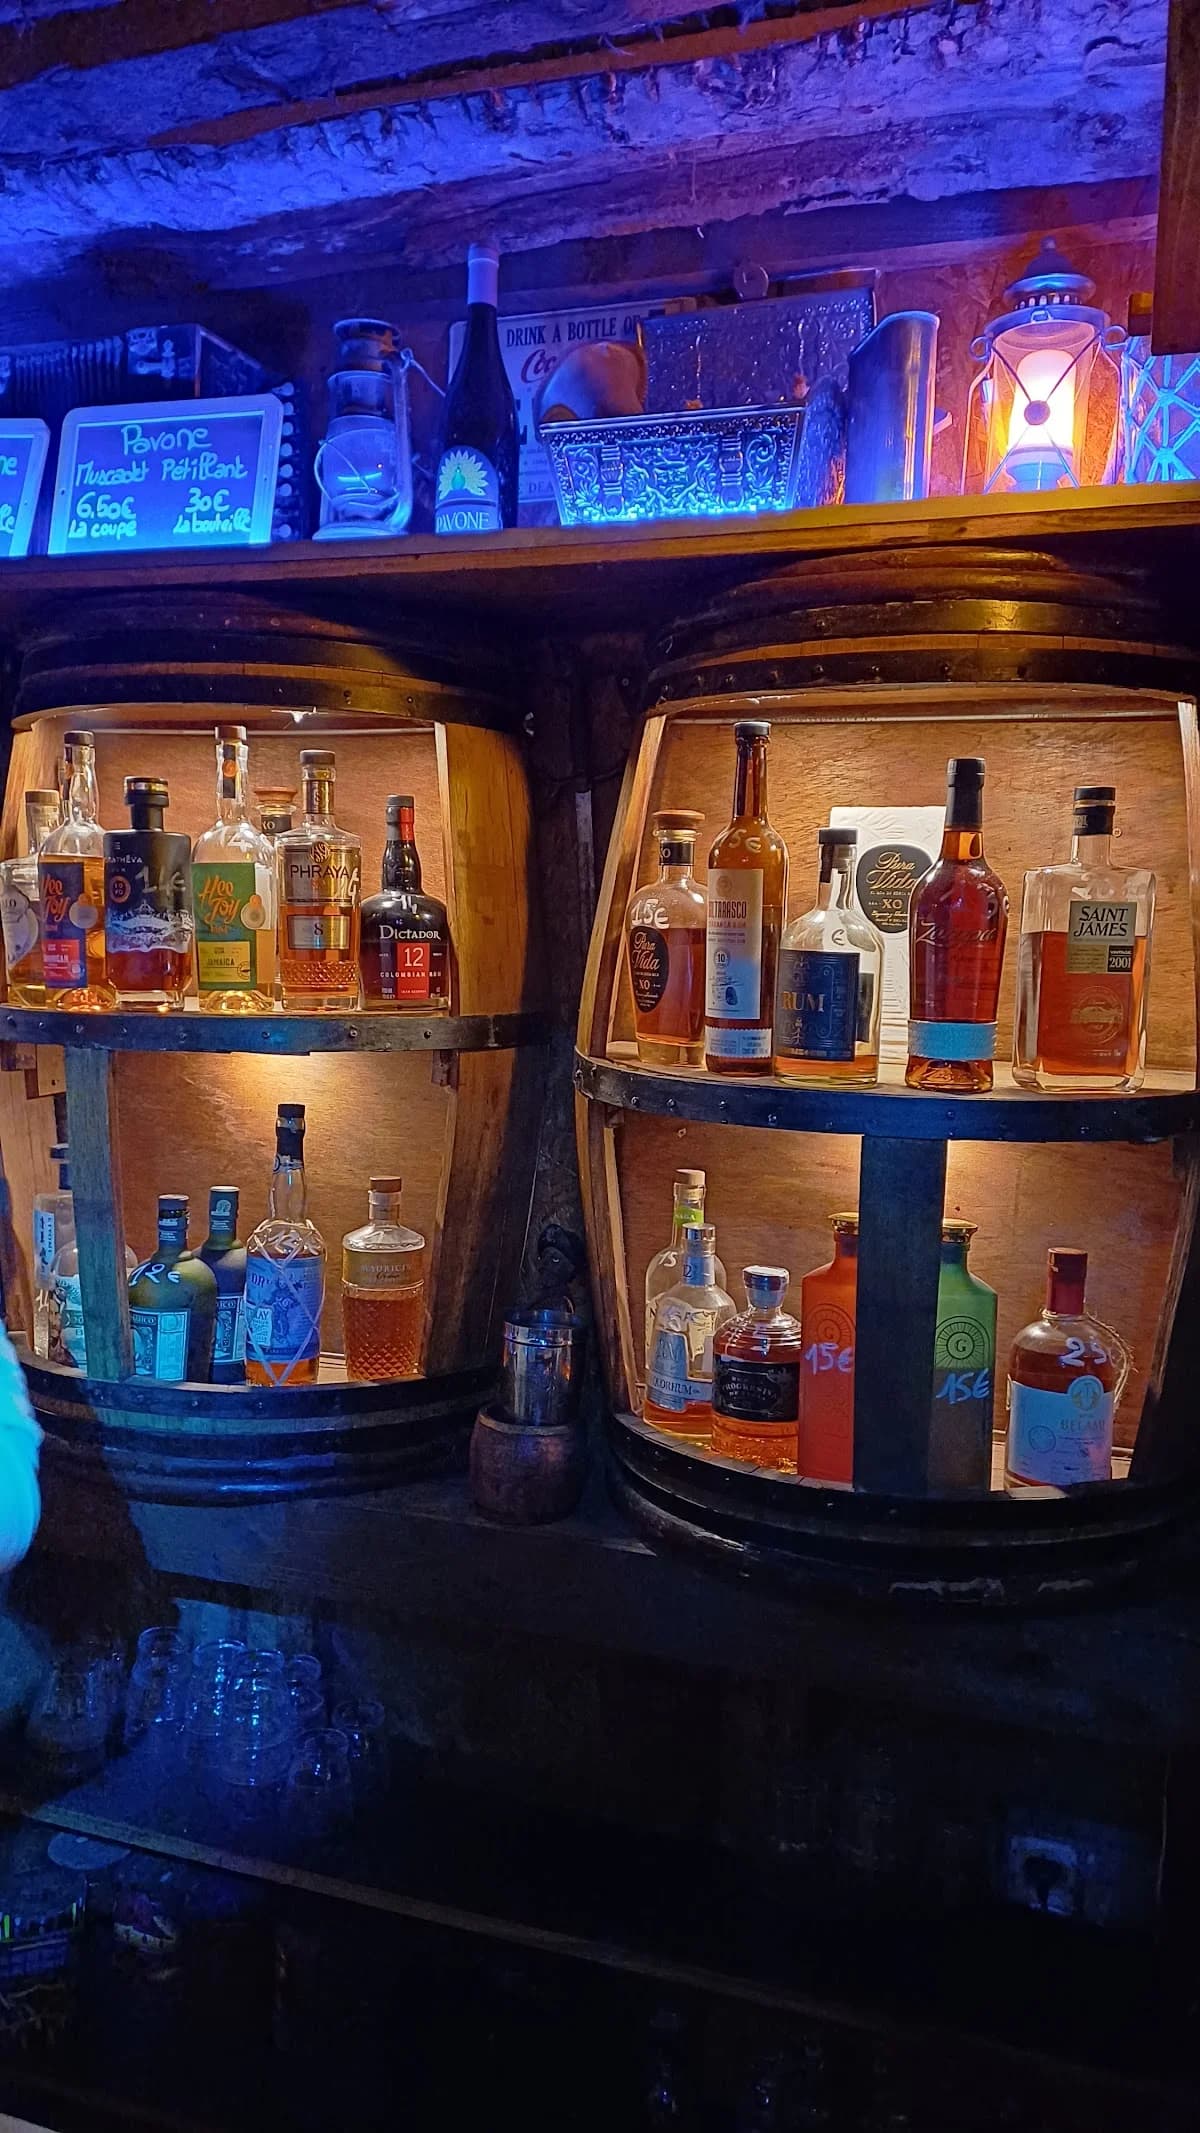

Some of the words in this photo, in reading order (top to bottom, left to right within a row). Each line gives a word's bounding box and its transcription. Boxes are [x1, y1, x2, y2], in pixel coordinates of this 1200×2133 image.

[506, 325, 547, 347] DRINK
[552, 323, 562, 343] A
[567, 317, 617, 341] BOTTLE
[121, 423, 212, 456] Pavone
[90, 521, 138, 541] coupe
[875, 851, 915, 870] Pura
[290, 864, 349, 878] PHRAYA
[631, 898, 670, 929] 15€
[882, 898, 903, 909] XO
[1079, 906, 1129, 922] SAINT
[1073, 922, 1129, 937] JAMES
[634, 931, 657, 951] Pura
[404, 947, 425, 967] 12
[632, 950, 661, 971] Vida
[782, 991, 825, 1012] RUM
[956, 1338, 967, 1353] G
[804, 1342, 854, 1375] 15€
